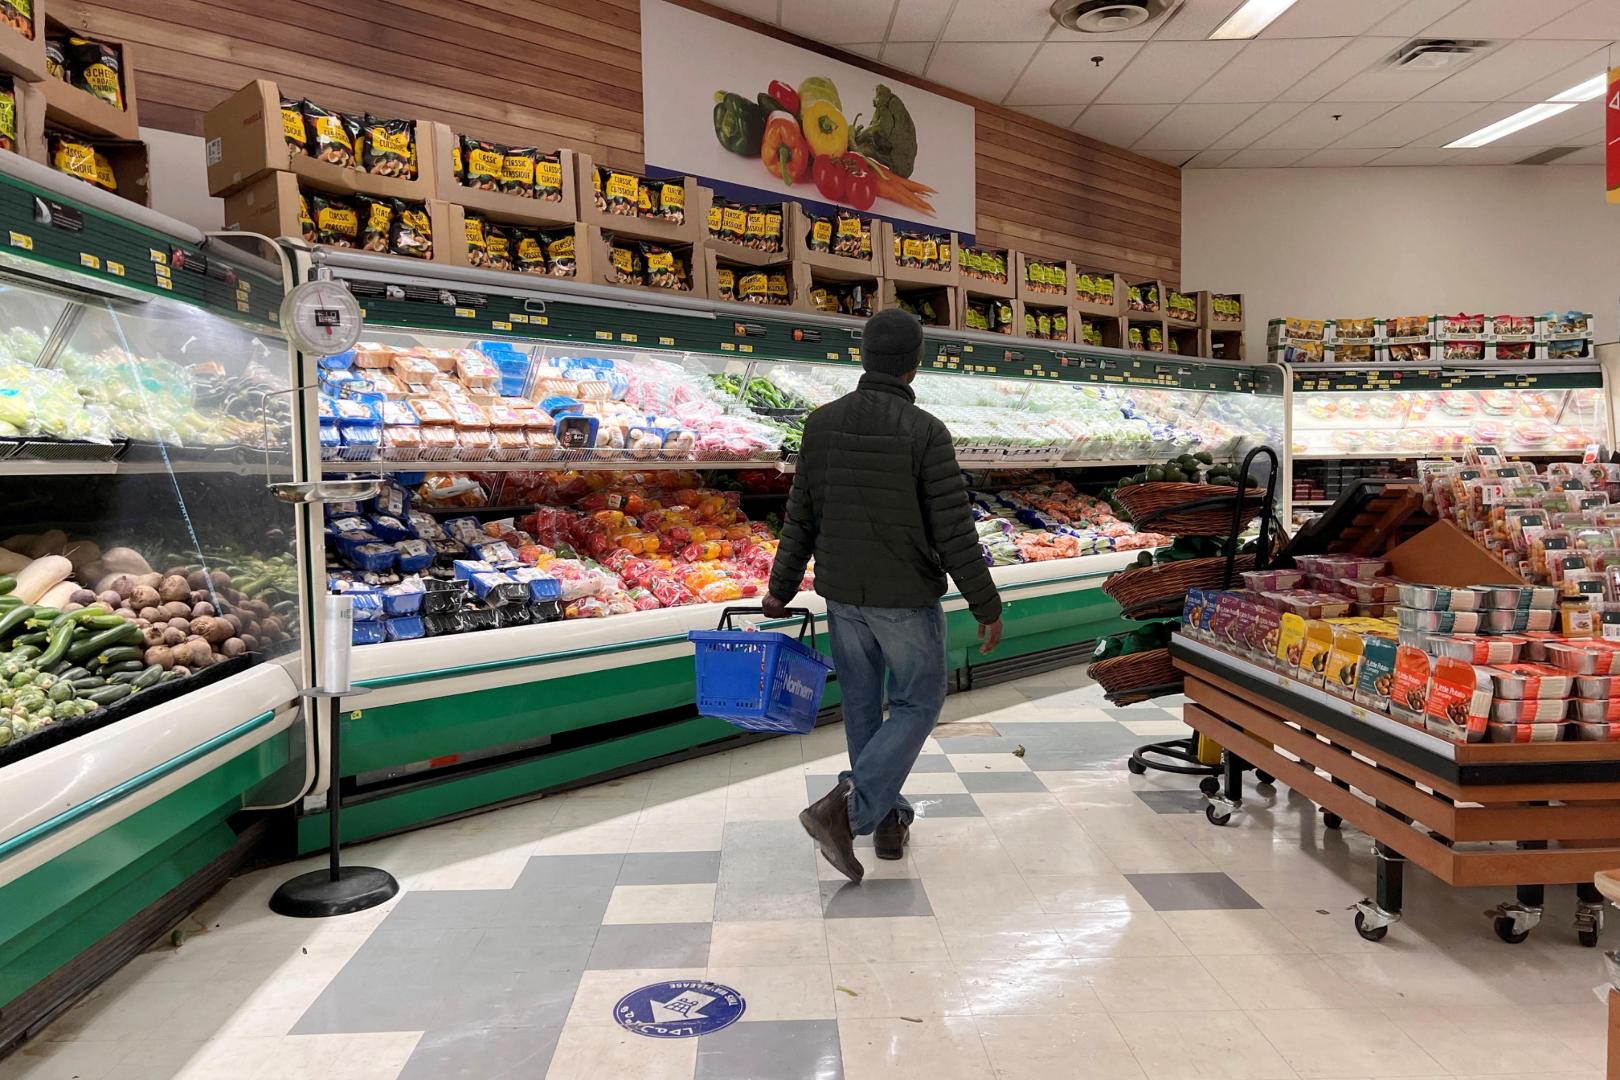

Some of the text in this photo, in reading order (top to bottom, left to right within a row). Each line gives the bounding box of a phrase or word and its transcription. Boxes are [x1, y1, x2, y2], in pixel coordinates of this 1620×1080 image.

[505, 159, 526, 168] CLASSIC
[328, 210, 350, 222] CLASSIC
[783, 673, 814, 701] Northern
[1436, 682, 1466, 699] Little Potato
